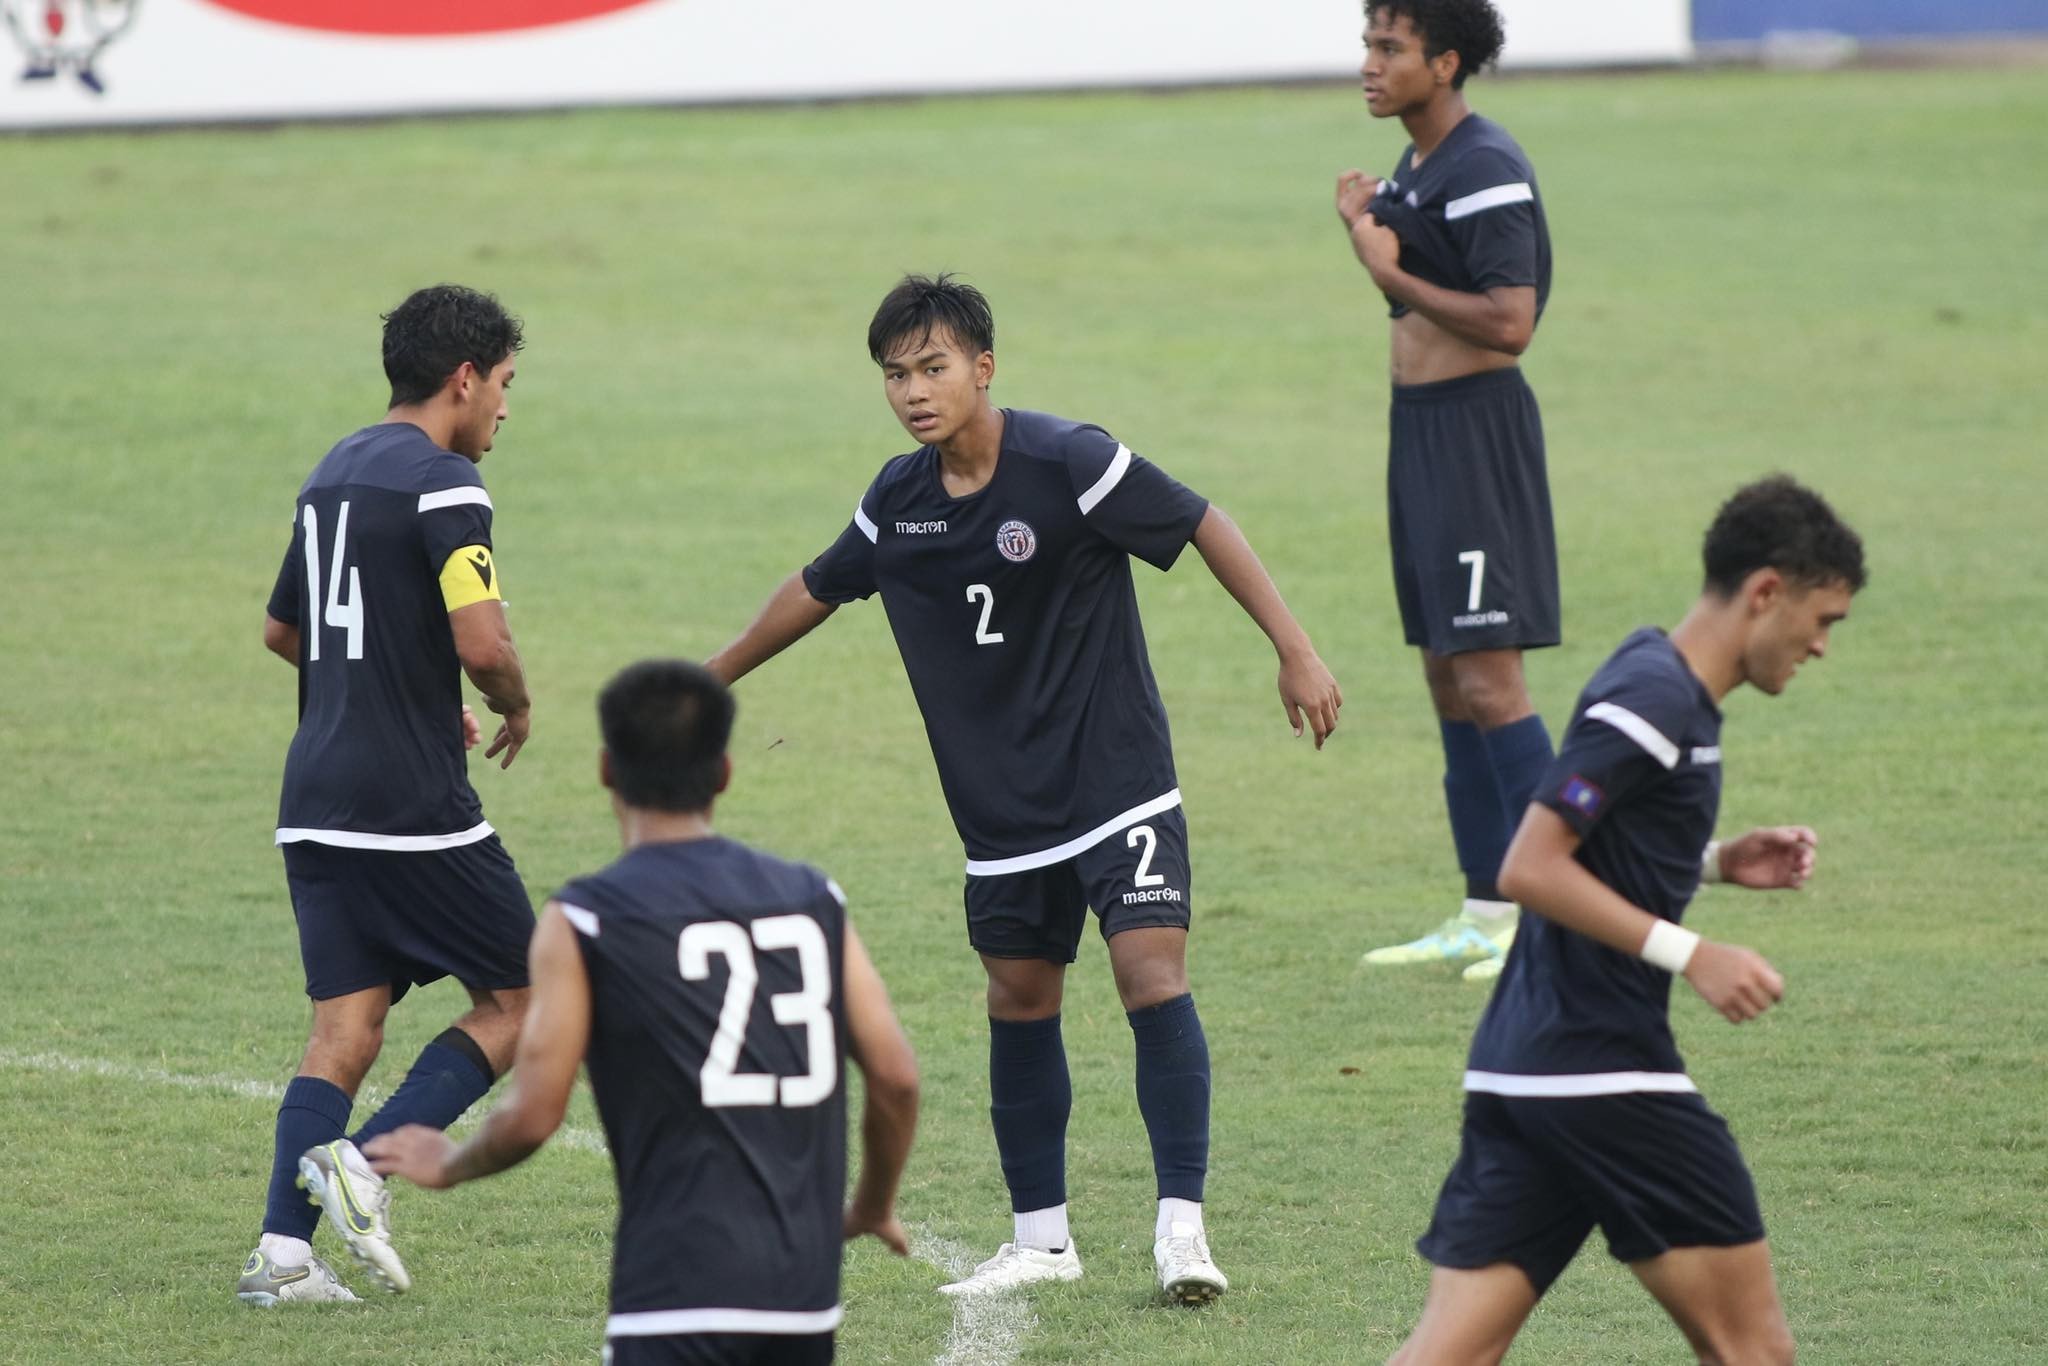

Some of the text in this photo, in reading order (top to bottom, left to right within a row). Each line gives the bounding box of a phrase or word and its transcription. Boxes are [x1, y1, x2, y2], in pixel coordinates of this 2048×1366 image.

[895, 520, 947, 535] macron
[303, 501, 364, 661] 14
[1458, 550, 1486, 611] 7
[966, 583, 1004, 645] 2
[1127, 825, 1164, 887] 2
[1123, 887, 1181, 904] macron
[678, 913, 837, 1108] 23
